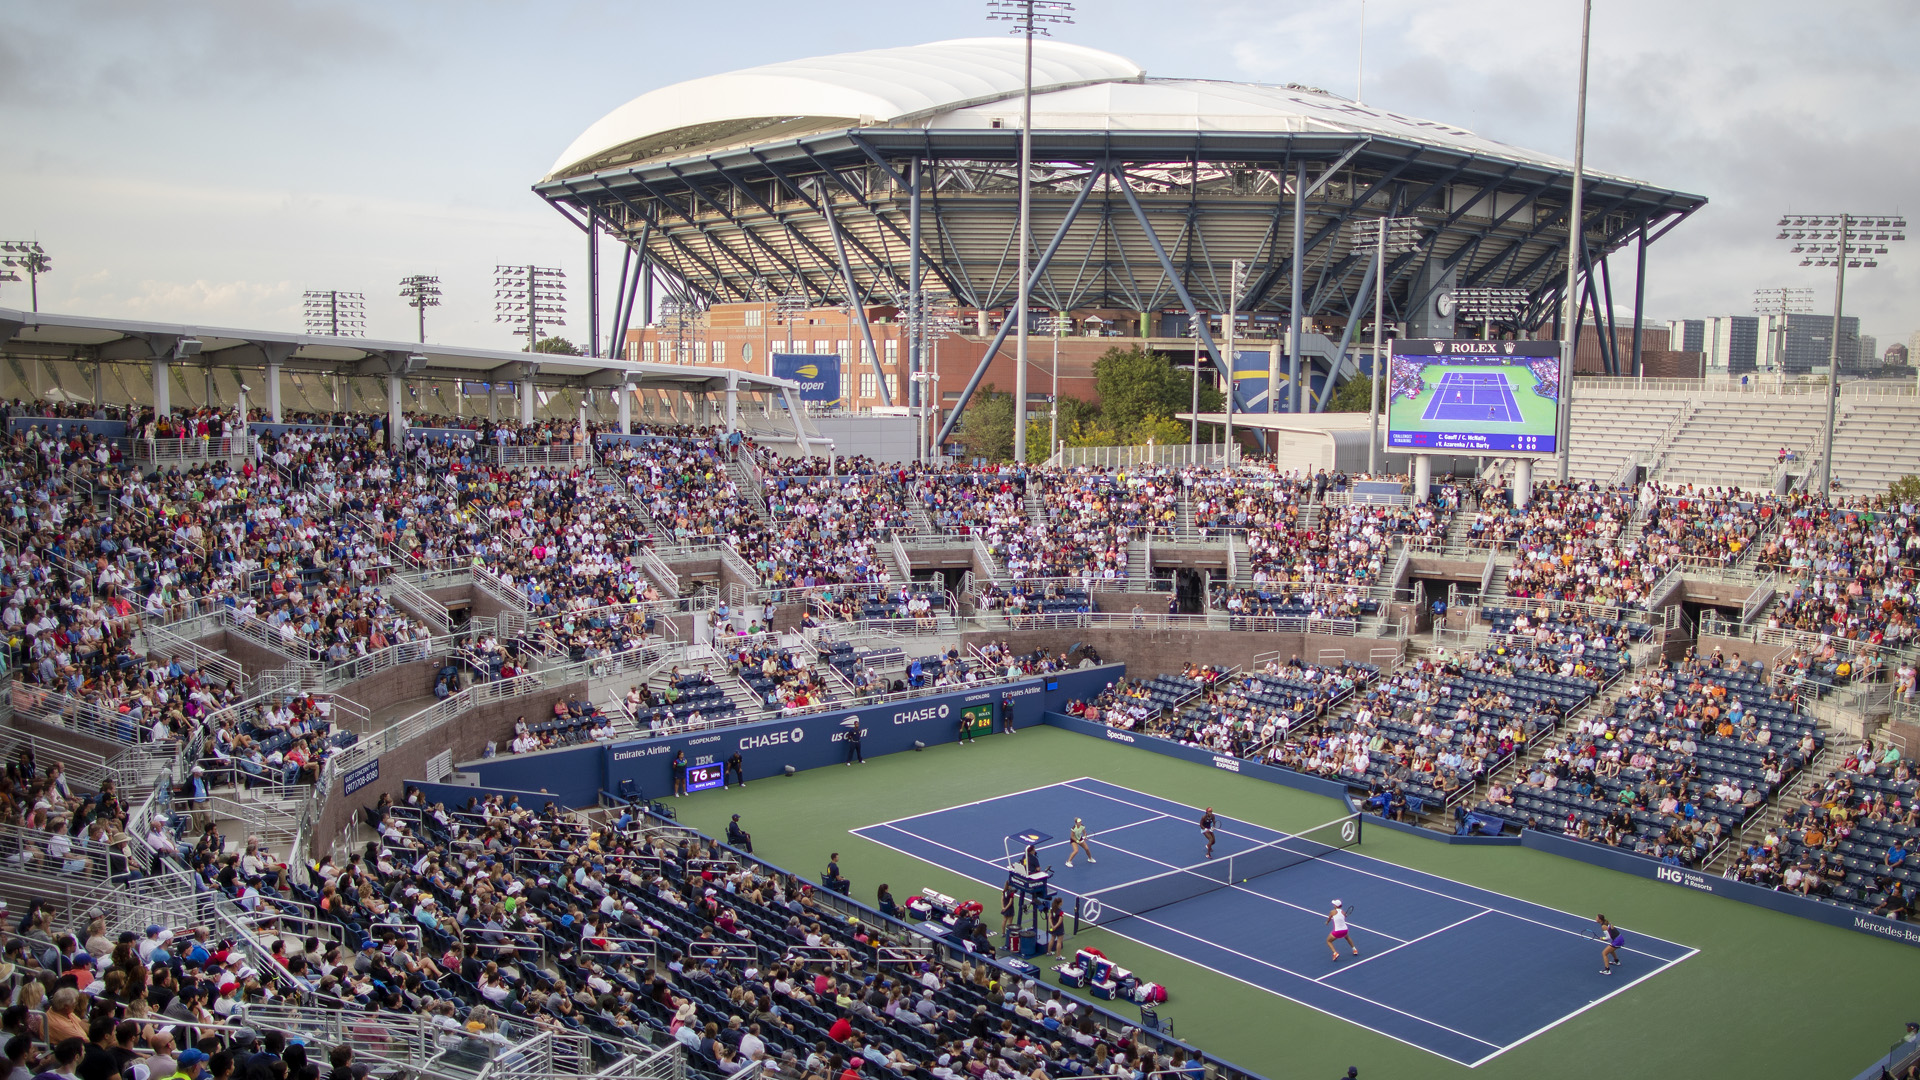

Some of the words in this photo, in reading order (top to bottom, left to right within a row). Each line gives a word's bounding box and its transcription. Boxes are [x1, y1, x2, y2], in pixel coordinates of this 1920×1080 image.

[1451, 344, 1497, 353] ROLEX
[801, 382, 824, 392] open
[1024, 686, 1041, 694] Airline
[964, 692, 990, 702] USOPEN.ORG
[894, 707, 936, 725] CHASE
[688, 736, 721, 745] USOPEN.ORG
[740, 731, 788, 750] CHASE
[1107, 730, 1133, 742] Spectrum
[614, 749, 645, 760] Emirates
[646, 745, 671, 756] Airline
[696, 754, 714, 766] IBM
[1213, 756, 1239, 766] AMERICAN
[1216, 762, 1239, 772] EXPRESS
[692, 770, 708, 782] 76
[1657, 866, 1682, 883] IHG
[1684, 873, 1704, 883] Hotels
[1690, 880, 1712, 891] Resorts
